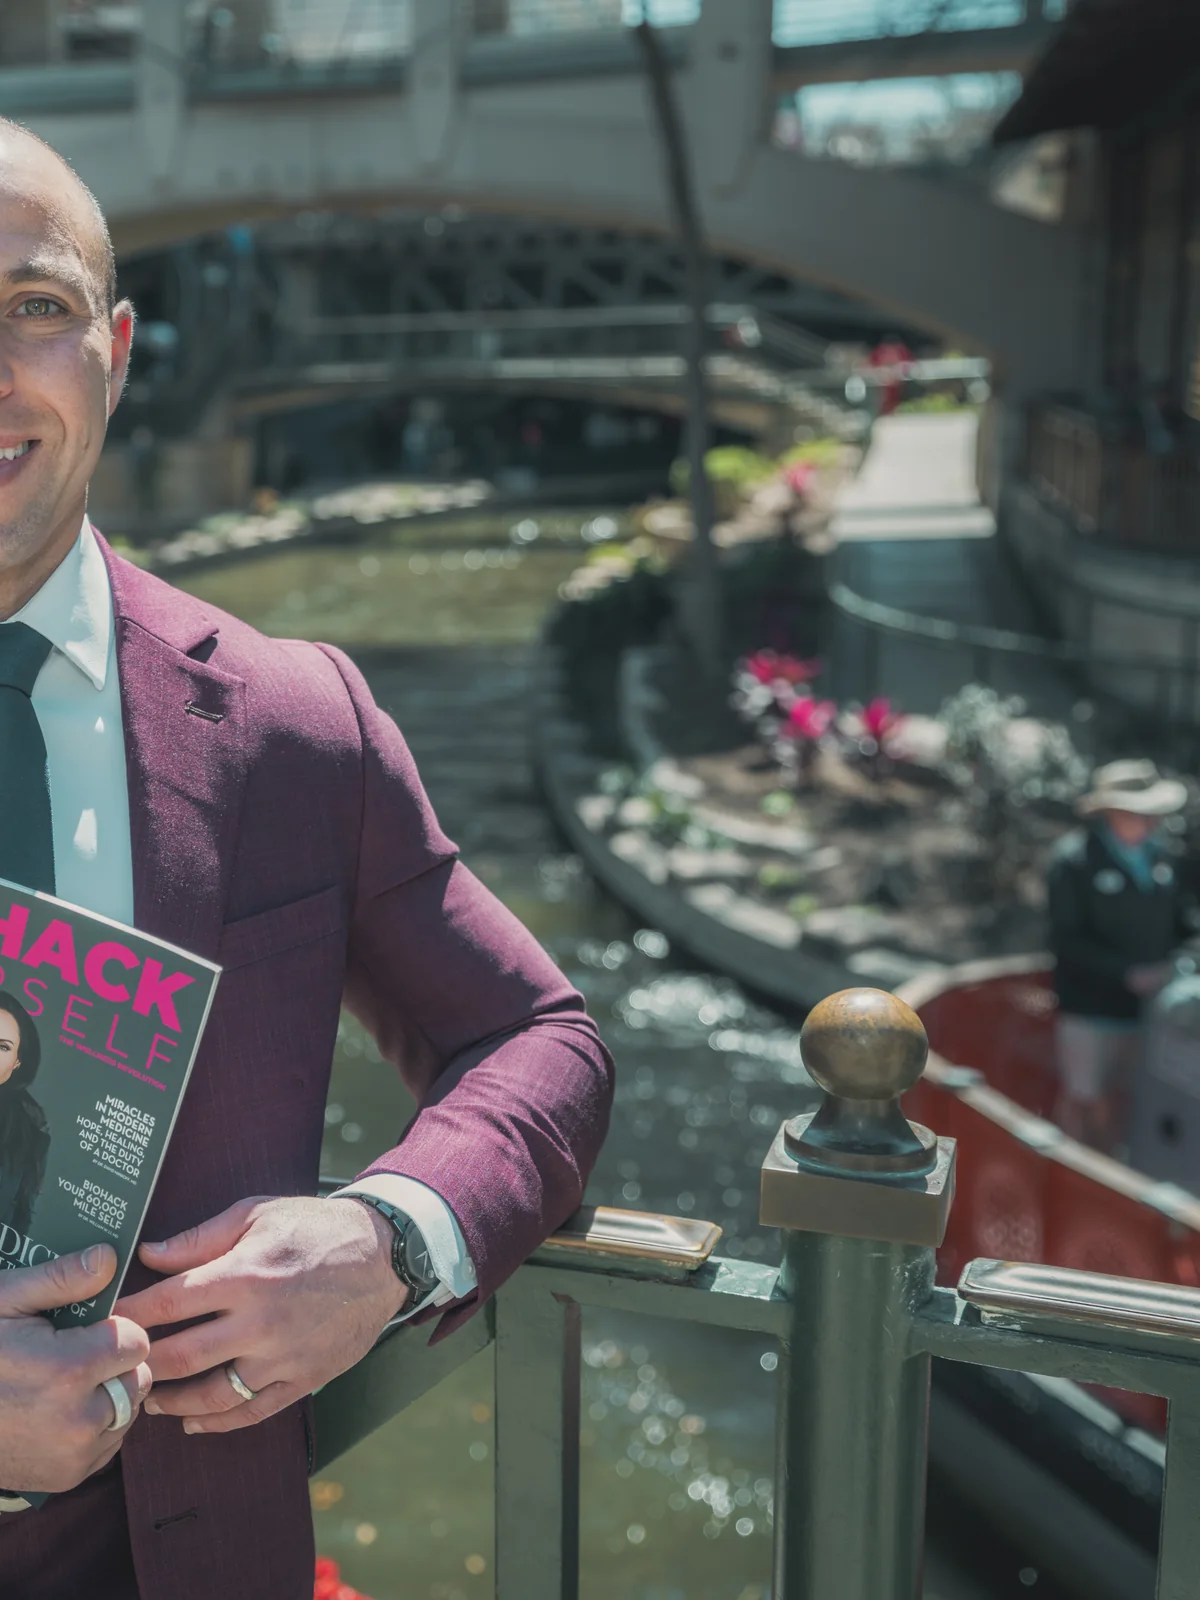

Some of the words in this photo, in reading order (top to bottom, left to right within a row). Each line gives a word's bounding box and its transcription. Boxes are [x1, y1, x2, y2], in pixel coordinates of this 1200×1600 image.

[59, 1034, 74, 1046] THE
[117, 1062, 166, 1092] REVOLUTION
[95, 1101, 107, 1113] IN
[108, 1106, 154, 1137] MODERN
[106, 1094, 156, 1128] MIRACLES
[76, 1115, 103, 1136] HOPE,
[105, 1130, 145, 1158] HEALING,
[78, 1129, 99, 1144] AND
[100, 1138, 118, 1154] THE
[118, 1148, 144, 1167] DUTY
[100, 1115, 150, 1148] MEDICINE
[80, 1140, 94, 1152] OF
[93, 1148, 100, 1158] A
[102, 1151, 140, 1178] DOCTOR
[58, 1177, 85, 1199] YOUR
[86, 1194, 125, 1220] 60,000
[73, 1198, 96, 1217] MILE
[98, 1211, 122, 1230] SELF
[82, 1180, 128, 1212] BIOHACK
[70, 1303, 88, 1318] OF
